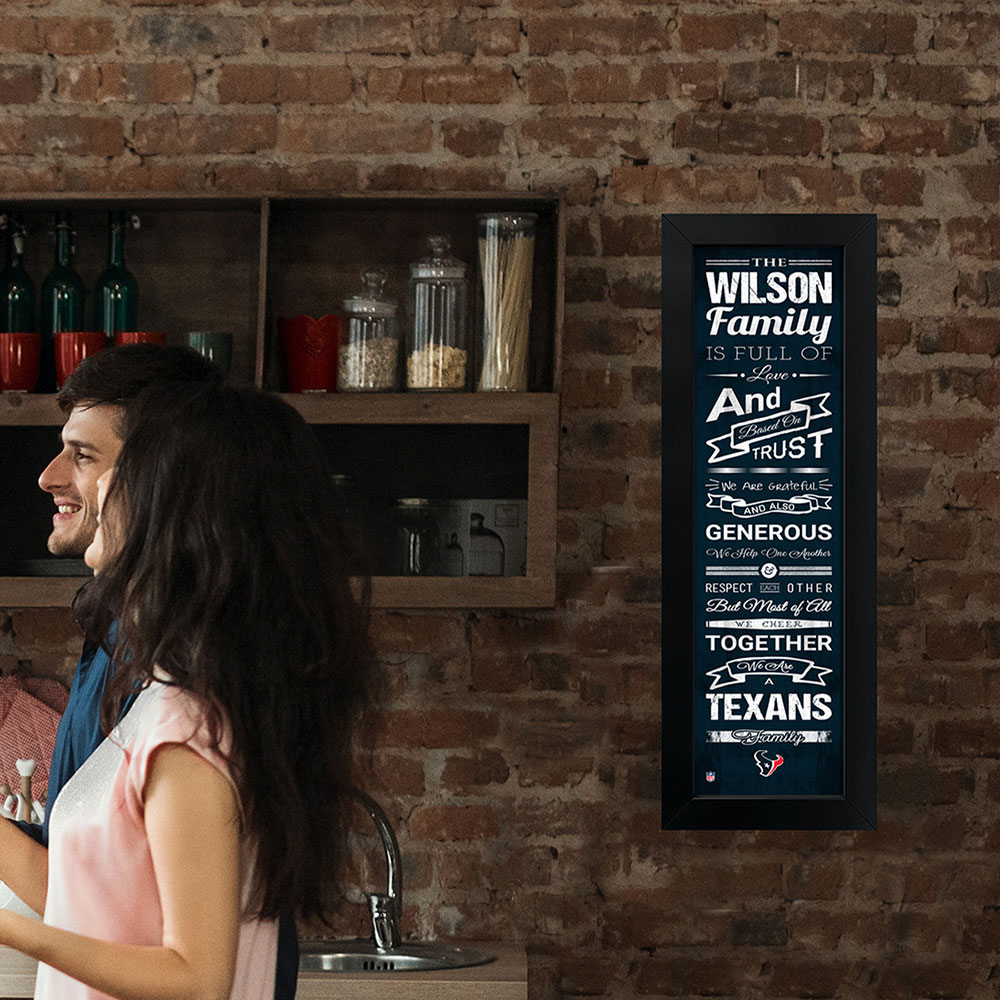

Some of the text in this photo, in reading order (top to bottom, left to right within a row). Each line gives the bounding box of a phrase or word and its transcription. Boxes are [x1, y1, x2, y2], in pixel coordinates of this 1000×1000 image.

[751, 258, 787, 267] THE
[705, 271, 833, 304] WILSON
[705, 306, 833, 345] Family
[706, 346, 833, 361] IS FULL OF
[746, 364, 790, 384] Love
[705, 386, 781, 423] And
[738, 414, 802, 439] Based On
[752, 428, 833, 460] TRUST
[721, 481, 737, 492] We
[743, 502, 795, 515] AND ALSO
[705, 524, 833, 541] GENEROUS
[705, 548, 832, 560] We Help One Another
[705, 583, 753, 593] RESPECT
[787, 583, 833, 593] OTHER
[705, 598, 833, 616] But Most of All
[705, 634, 833, 652] TOGETHER
[736, 660, 794, 673] We Are
[705, 693, 833, 720] TEXANS
[731, 728, 806, 746] Family
